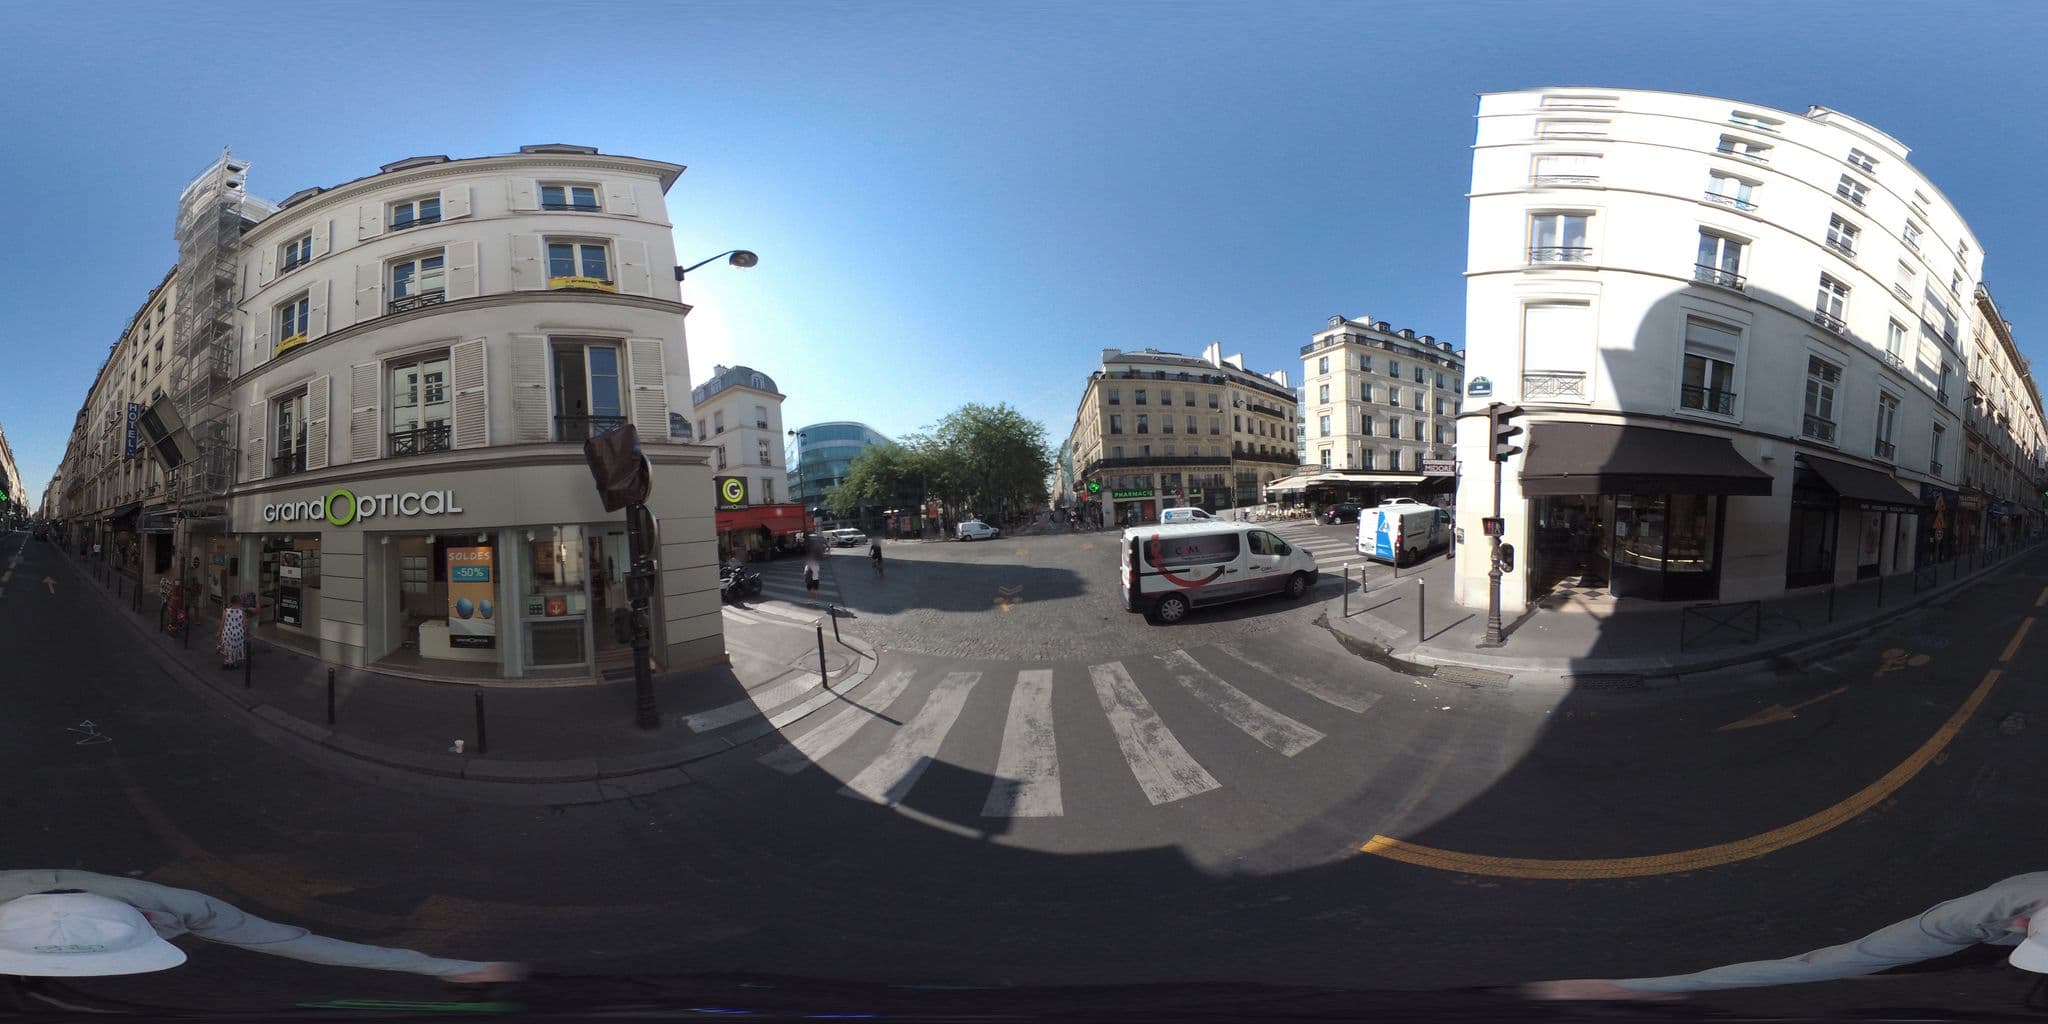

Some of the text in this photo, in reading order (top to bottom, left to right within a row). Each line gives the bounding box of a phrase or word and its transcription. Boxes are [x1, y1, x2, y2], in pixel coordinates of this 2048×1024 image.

[128, 404, 137, 448] HOTEL
[727, 482, 741, 499] G
[1113, 490, 1154, 498] PHARMACIE
[447, 551, 491, 561] SOLDES
[456, 567, 484, 577] -50%
